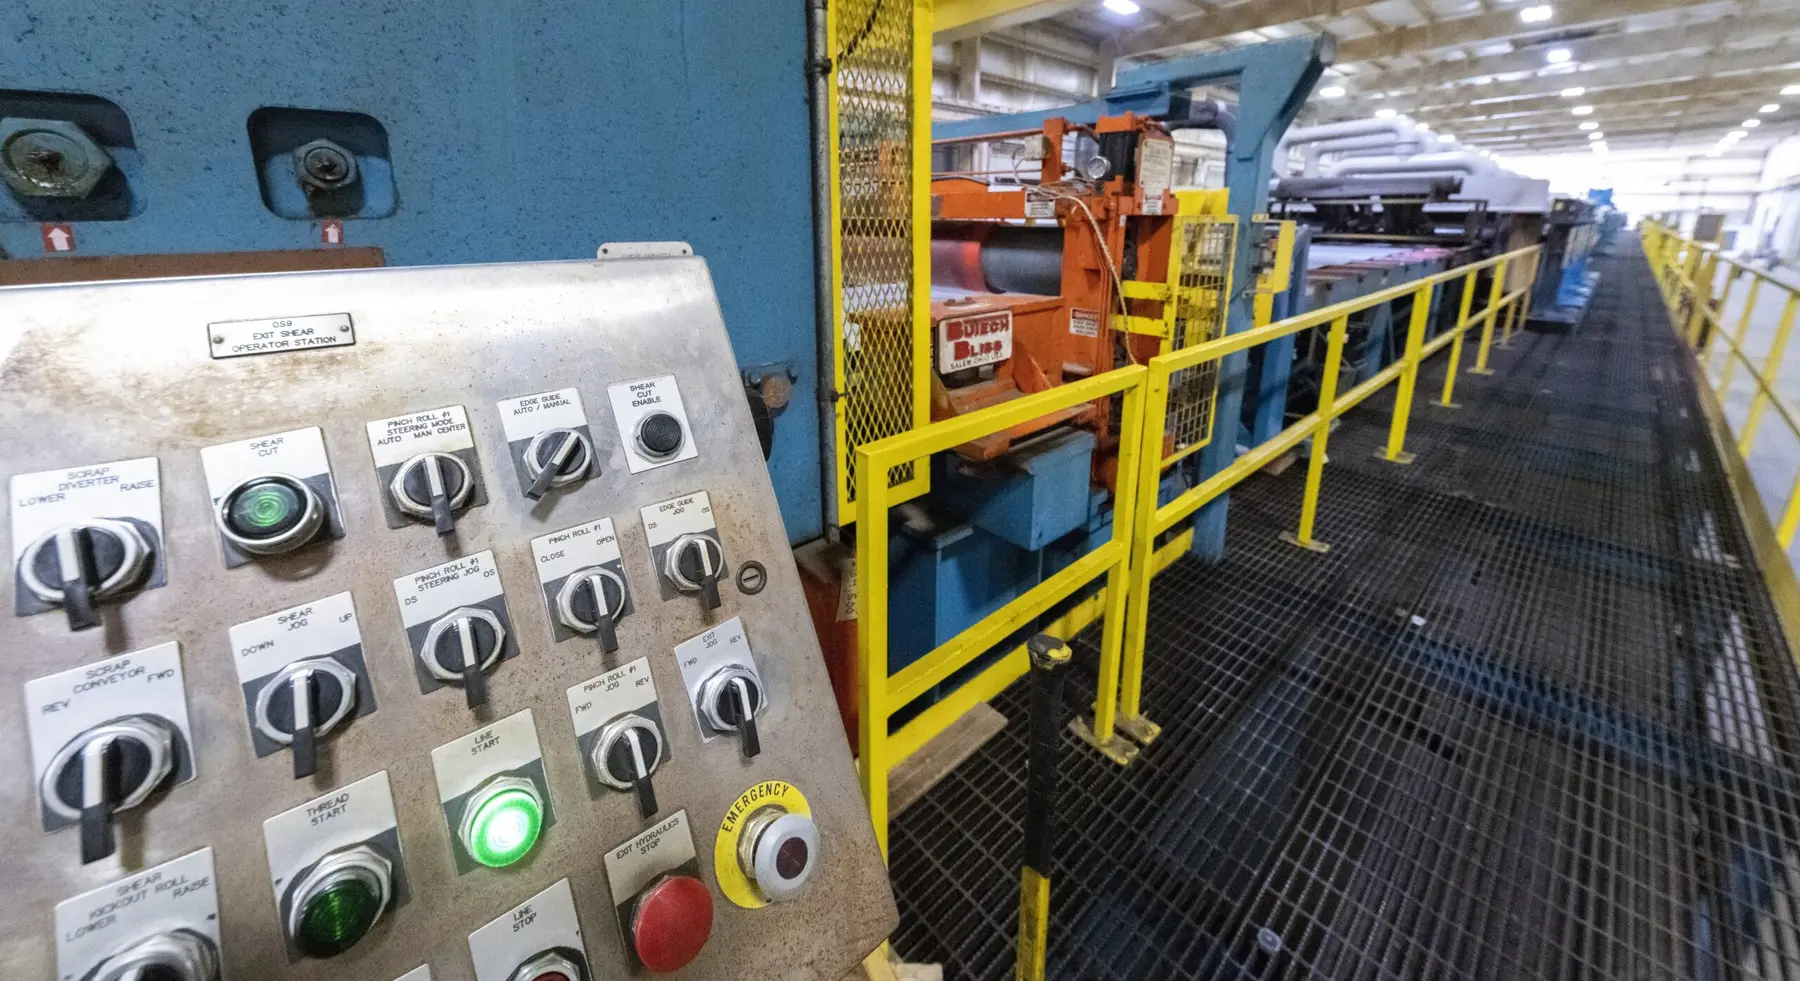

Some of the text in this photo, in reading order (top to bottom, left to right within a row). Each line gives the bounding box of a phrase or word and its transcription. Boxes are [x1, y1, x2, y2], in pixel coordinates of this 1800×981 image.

[272, 320, 293, 328] OS9
[253, 328, 314, 340] EXIT SHEAR
[232, 336, 337, 353] OPERATOR STATION
[950, 359, 972, 370] SALEM
[629, 381, 656, 392] SHEAR
[520, 393, 562, 407] EDGE GUIDE
[636, 390, 652, 398] CUT
[513, 406, 534, 416] AUTO
[543, 399, 571, 410] MANUAL
[632, 396, 662, 408] ENABLE
[387, 418, 454, 436] STEERING MODE
[388, 418, 413, 428] PINCH
[416, 414, 438, 422] ROLL
[377, 423, 466, 446] AUTO MAN CENTER
[249, 437, 284, 450] SHEAR
[258, 447, 278, 457] CUT
[67, 467, 110, 480] SCRAP
[58, 475, 120, 491] DIVERTER
[120, 480, 155, 492] RAISE
[19, 493, 66, 507] LOWER
[659, 497, 694, 513] EDGE GUIDE
[672, 507, 685, 515] JOG
[701, 506, 711, 514] OS
[648, 522, 658, 530] DS
[549, 524, 601, 545] PINCH ROLL #1
[596, 535, 615, 546] OPEN
[540, 550, 566, 563] CLOSE
[414, 557, 479, 585] PINCH ROLL #1
[483, 568, 495, 578] OS
[418, 566, 480, 592] STEERING JOG
[404, 595, 418, 606] DS
[277, 607, 314, 624] SHEAR
[339, 612, 353, 623] UP
[287, 618, 308, 631] JOG
[702, 631, 715, 643] EXIT
[706, 638, 718, 648] JOG
[729, 634, 742, 644] REV
[241, 639, 274, 657] DOWN
[86, 659, 131, 679] SCRAP
[684, 657, 698, 668] FWD
[73, 666, 146, 694] CONVEYOR
[147, 668, 175, 683] FWD
[583, 679, 605, 693] PINCH
[607, 671, 626, 683] ROLL
[635, 676, 650, 687] REV
[606, 681, 620, 692] JOG
[42, 698, 71, 716] REV
[575, 701, 592, 714] FWD
[475, 730, 493, 744] LINE
[471, 736, 500, 755] START
[306, 793, 350, 817] THREAD
[721, 783, 790, 833] EMERGENCY
[310, 804, 347, 827] START
[616, 817, 680, 860] EXIT HYDRAULICS
[640, 838, 661, 855] STOP
[116, 872, 163, 896] SHEAR
[173, 876, 211, 898] RAISE
[89, 875, 190, 920] KICKOUT ROLL
[513, 904, 533, 922] LINE
[66, 914, 117, 942] LOWER
[512, 912, 537, 932] STOP
